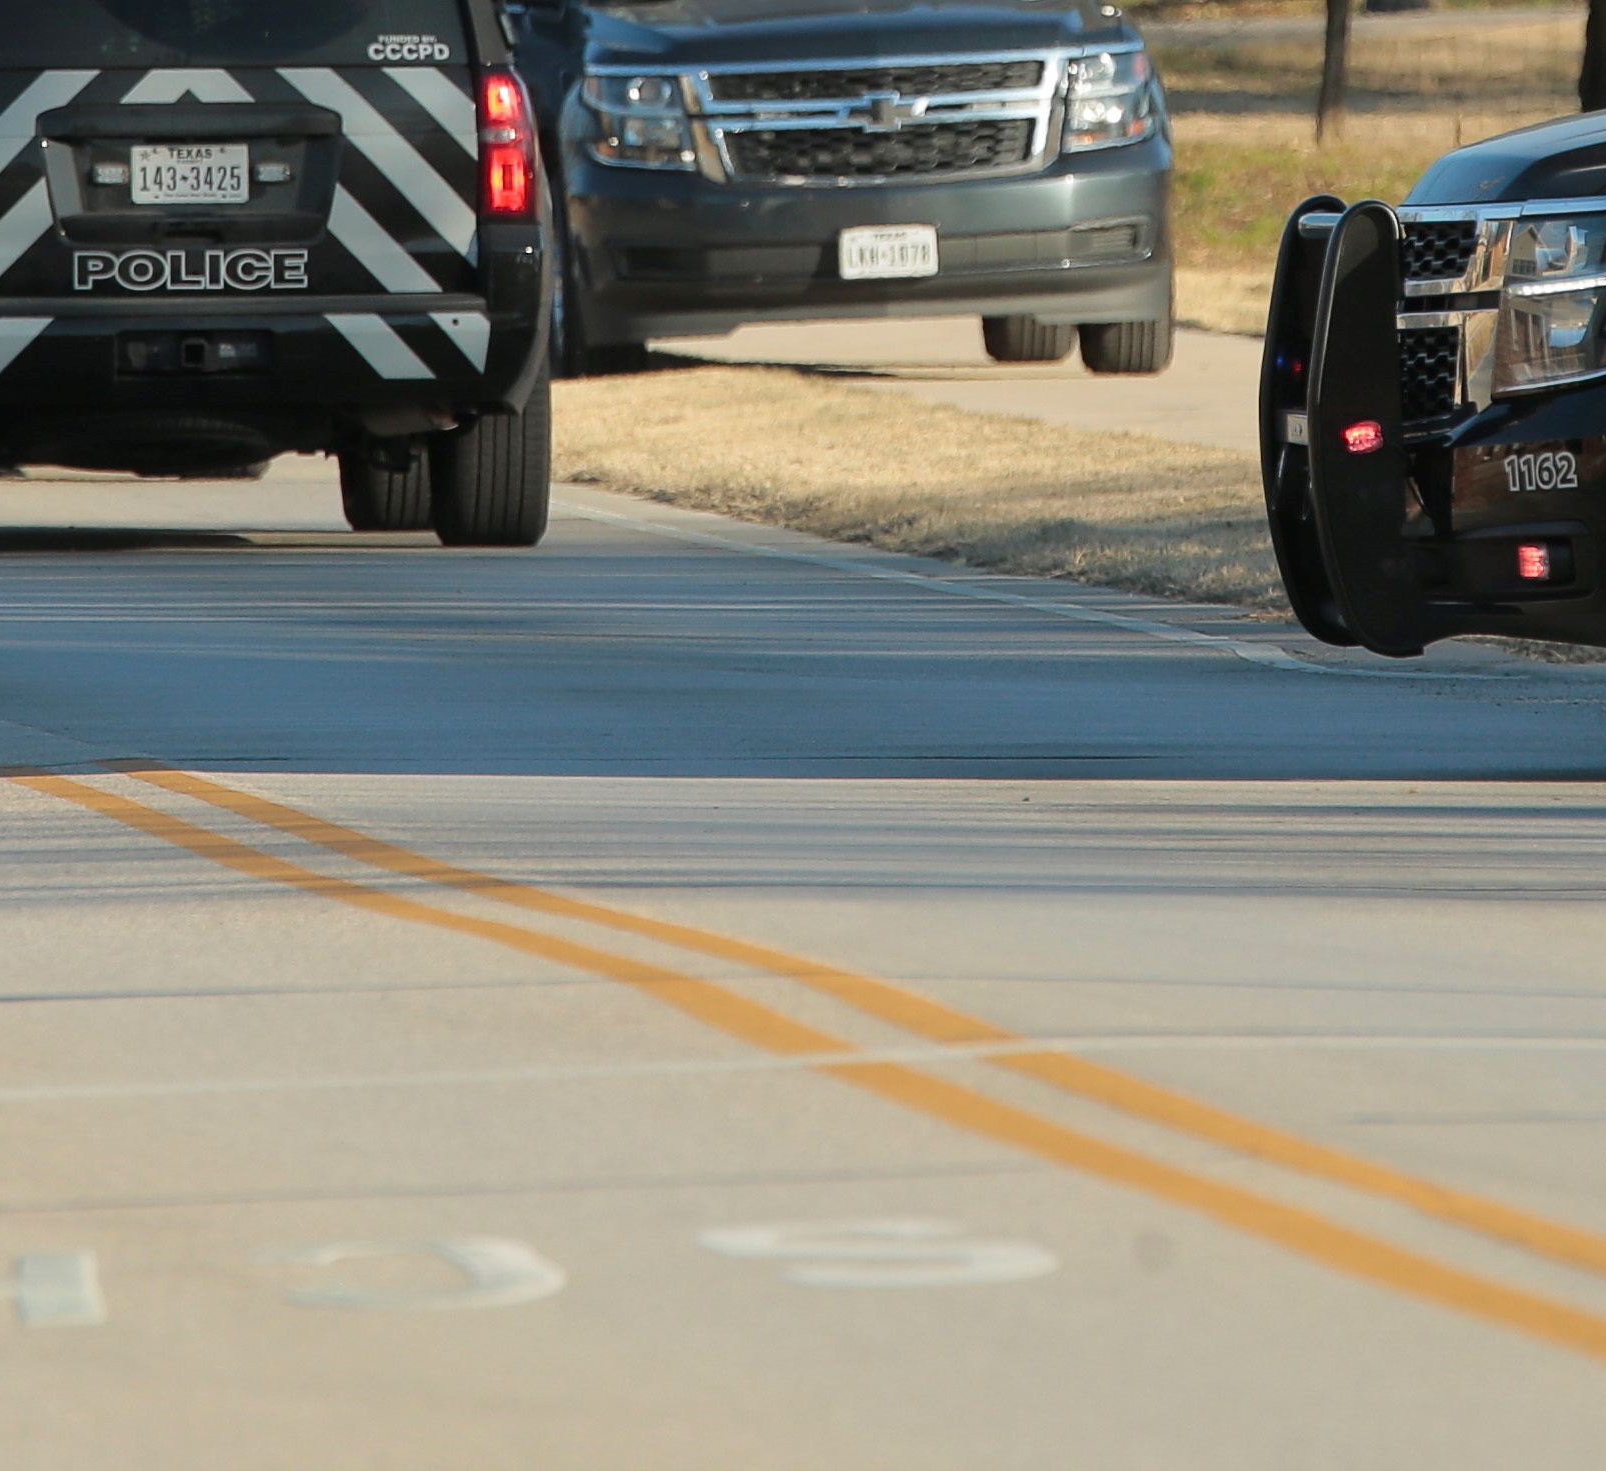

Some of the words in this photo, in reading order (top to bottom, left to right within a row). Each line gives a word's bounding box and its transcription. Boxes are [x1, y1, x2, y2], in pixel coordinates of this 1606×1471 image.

[368, 43, 450, 61] CCCPD
[168, 148, 213, 159] TEXAS
[73, 249, 308, 291] POLICE
[1504, 451, 1578, 492] 1162
